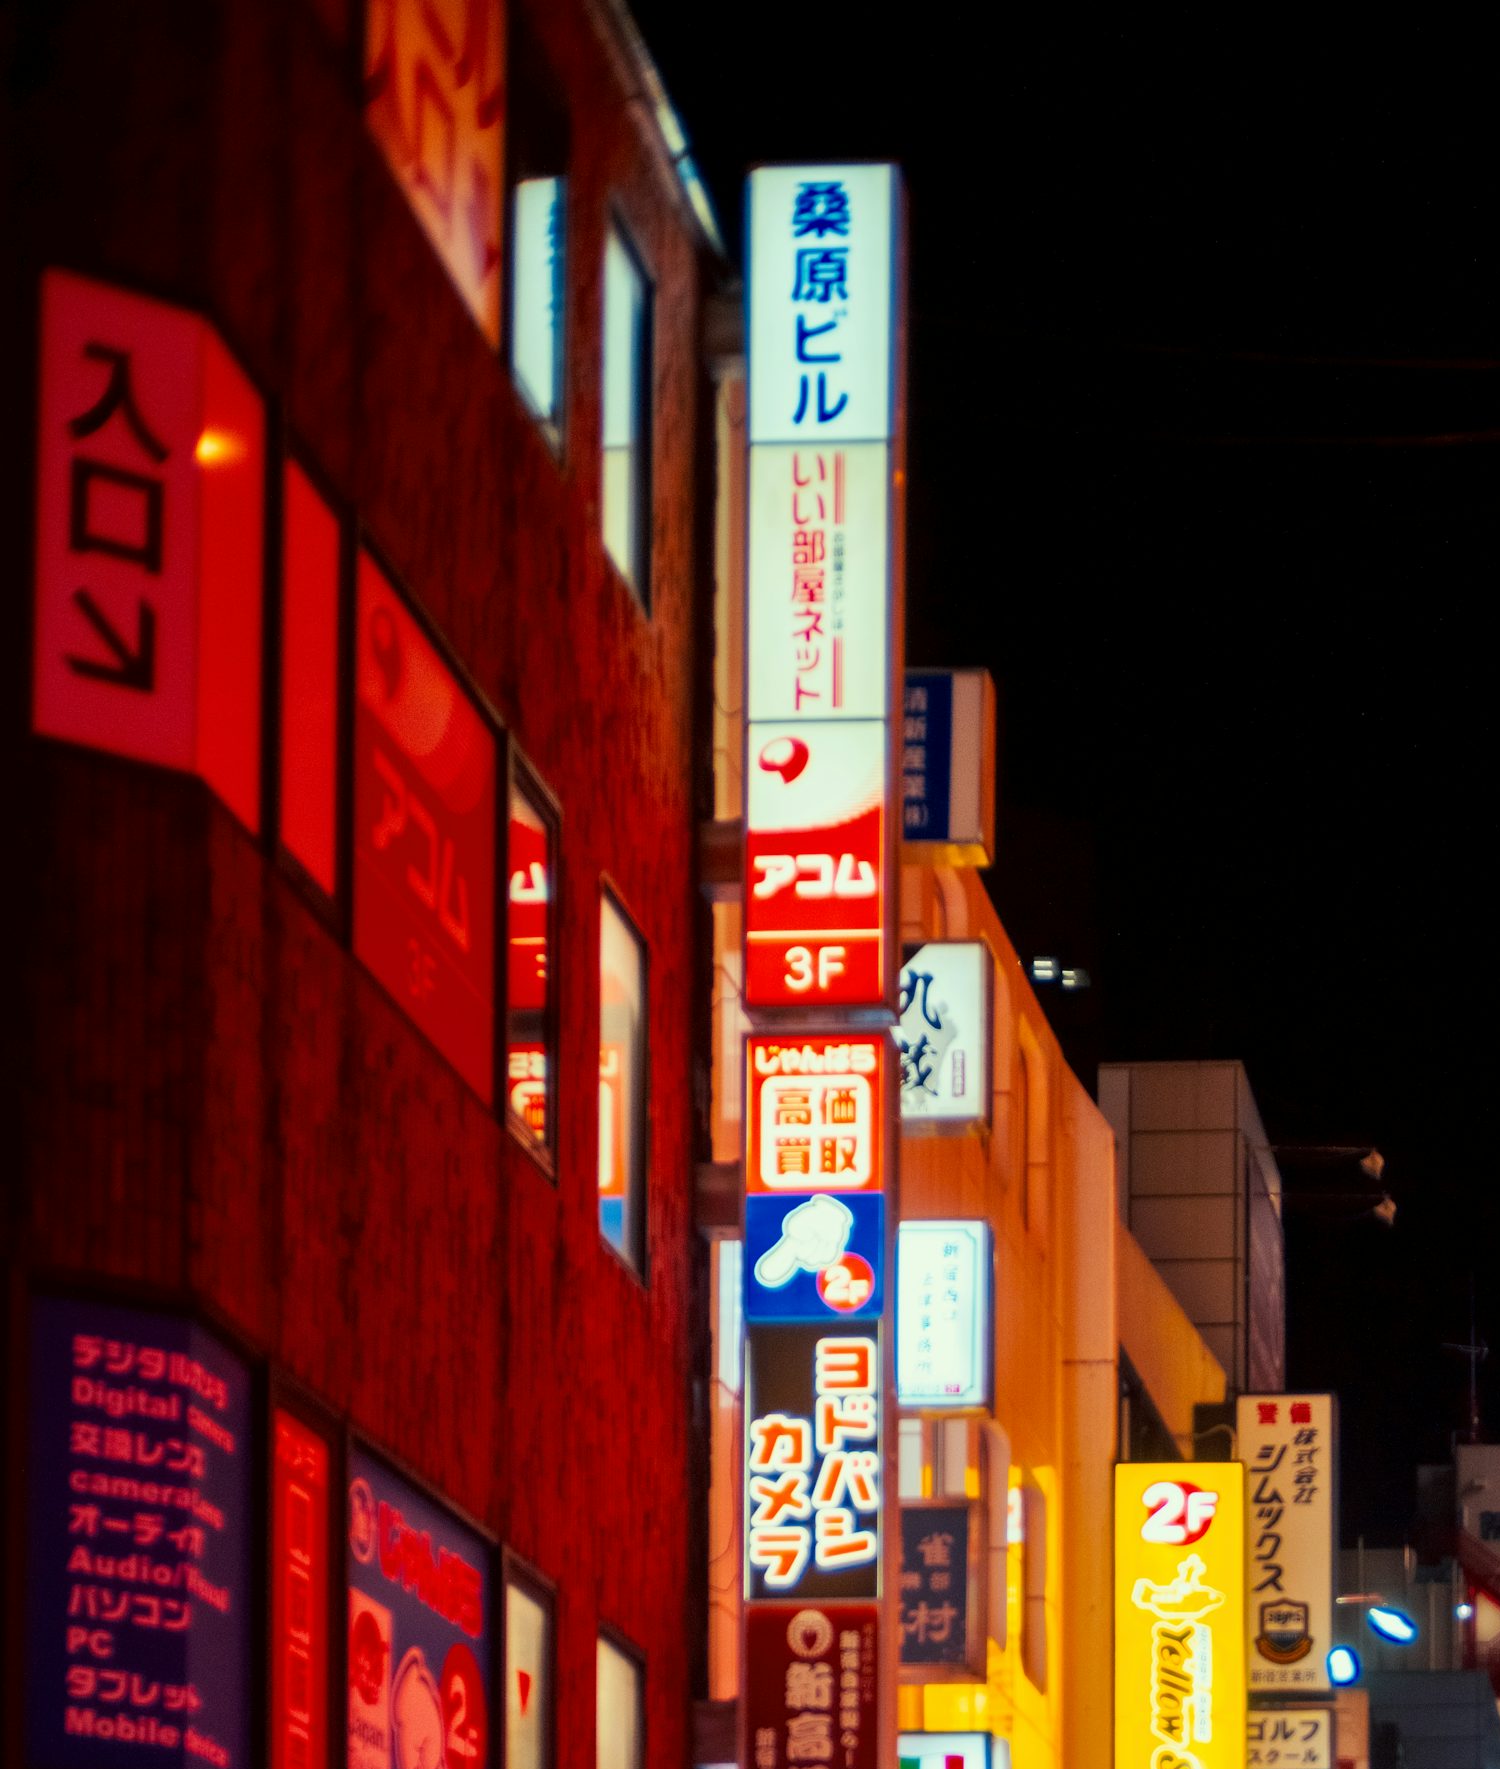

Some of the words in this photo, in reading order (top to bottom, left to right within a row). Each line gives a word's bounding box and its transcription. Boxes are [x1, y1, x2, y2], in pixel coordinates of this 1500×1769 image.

[791, 181, 852, 426] 桑原ビル
[69, 342, 169, 573] 入口
[791, 452, 826, 712] いい部屋ネット
[753, 853, 877, 898] アコム
[784, 945, 847, 991] 3F
[753, 1042, 876, 1075] じゃんぱら
[773, 1085, 859, 1126] 高価
[773, 1133, 859, 1176] 買取
[824, 1265, 872, 1305] 2F
[72, 1376, 179, 1421] Digital
[1256, 1402, 1312, 1426] 警備
[814, 1335, 879, 1572] ヨドバシ
[1292, 1426, 1318, 1505] 株式会社
[748, 1412, 812, 1590] カメラ
[1140, 1481, 1219, 1546] 2F
[1250, 1441, 1287, 1593] シムックス
[67, 1585, 192, 1630] パソコン
[66, 1627, 114, 1659] PC
[1154, 1622, 1194, 1742] Yellow
[65, 1706, 181, 1748] Mobile
[1247, 1719, 1321, 1743] ゴルフ
[1247, 1748, 1320, 1766] スクール
